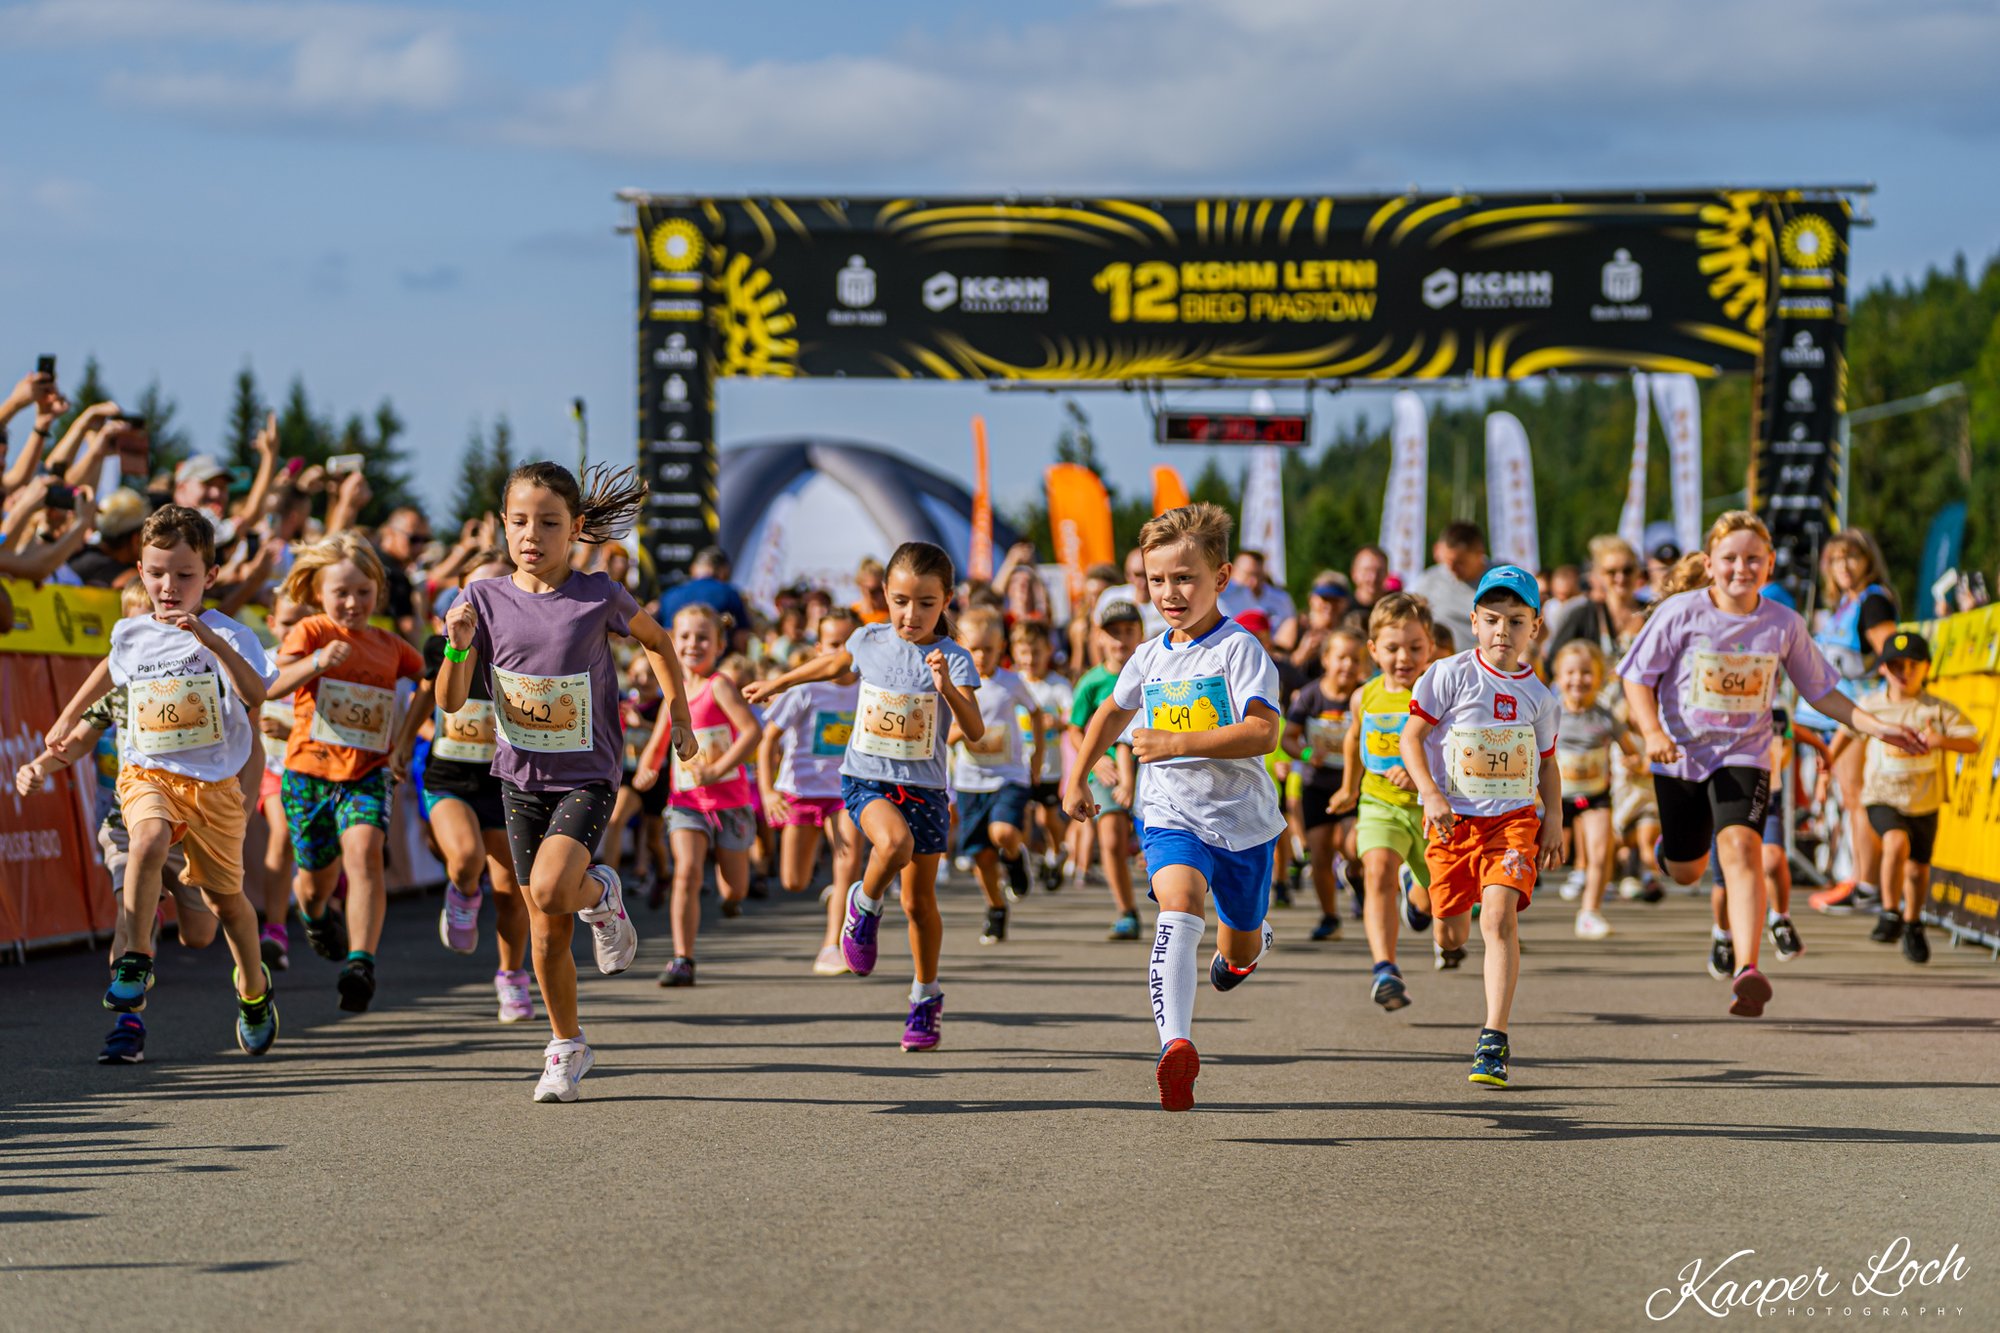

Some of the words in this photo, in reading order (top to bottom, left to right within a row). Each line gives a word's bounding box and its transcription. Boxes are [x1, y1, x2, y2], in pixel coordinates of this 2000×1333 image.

[1181, 260, 1278, 291] KGHM
[1283, 259, 1378, 290] LETNI
[1092, 261, 1180, 323] 12
[1180, 292, 1247, 323] BIEG
[137, 662, 156, 674] Pan
[158, 653, 200, 669] kierownik
[1722, 672, 1746, 691] 64
[157, 703, 180, 724] 18
[346, 703, 371, 726] 58
[521, 700, 552, 723] 42
[879, 711, 906, 734] 59
[1169, 707, 1191, 730] 49
[454, 718, 480, 737] 45
[1487, 751, 1509, 772] 79
[1152, 924, 1174, 964] HIGH
[1150, 968, 1165, 1027] JUMP
